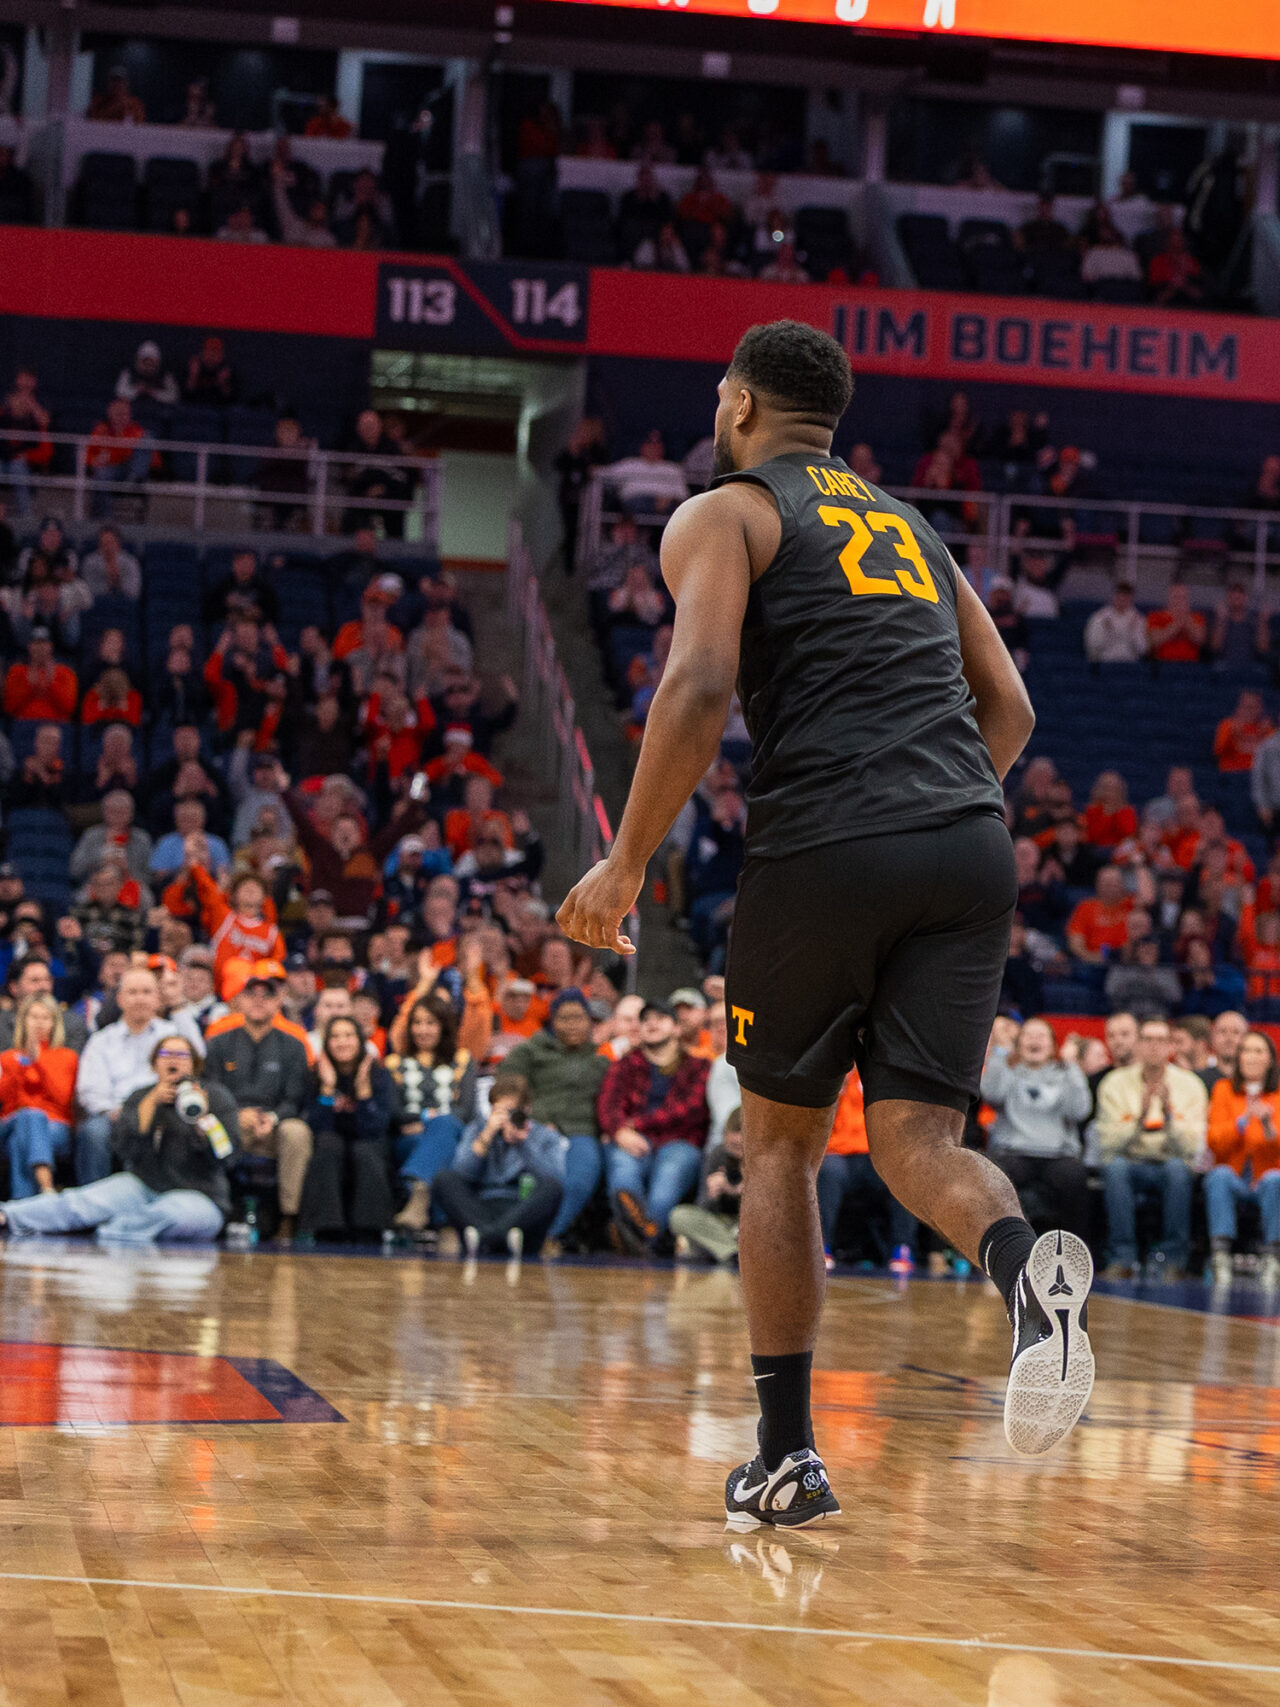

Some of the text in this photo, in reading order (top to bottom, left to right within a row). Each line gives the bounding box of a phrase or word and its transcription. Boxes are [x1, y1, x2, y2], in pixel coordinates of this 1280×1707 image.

[387, 276, 457, 326] 113
[510, 277, 582, 328] 114
[951, 312, 1239, 382] BOEHEIM
[805, 465, 877, 502] CAREY
[816, 504, 940, 604] 23
[731, 1004, 755, 1047] T
